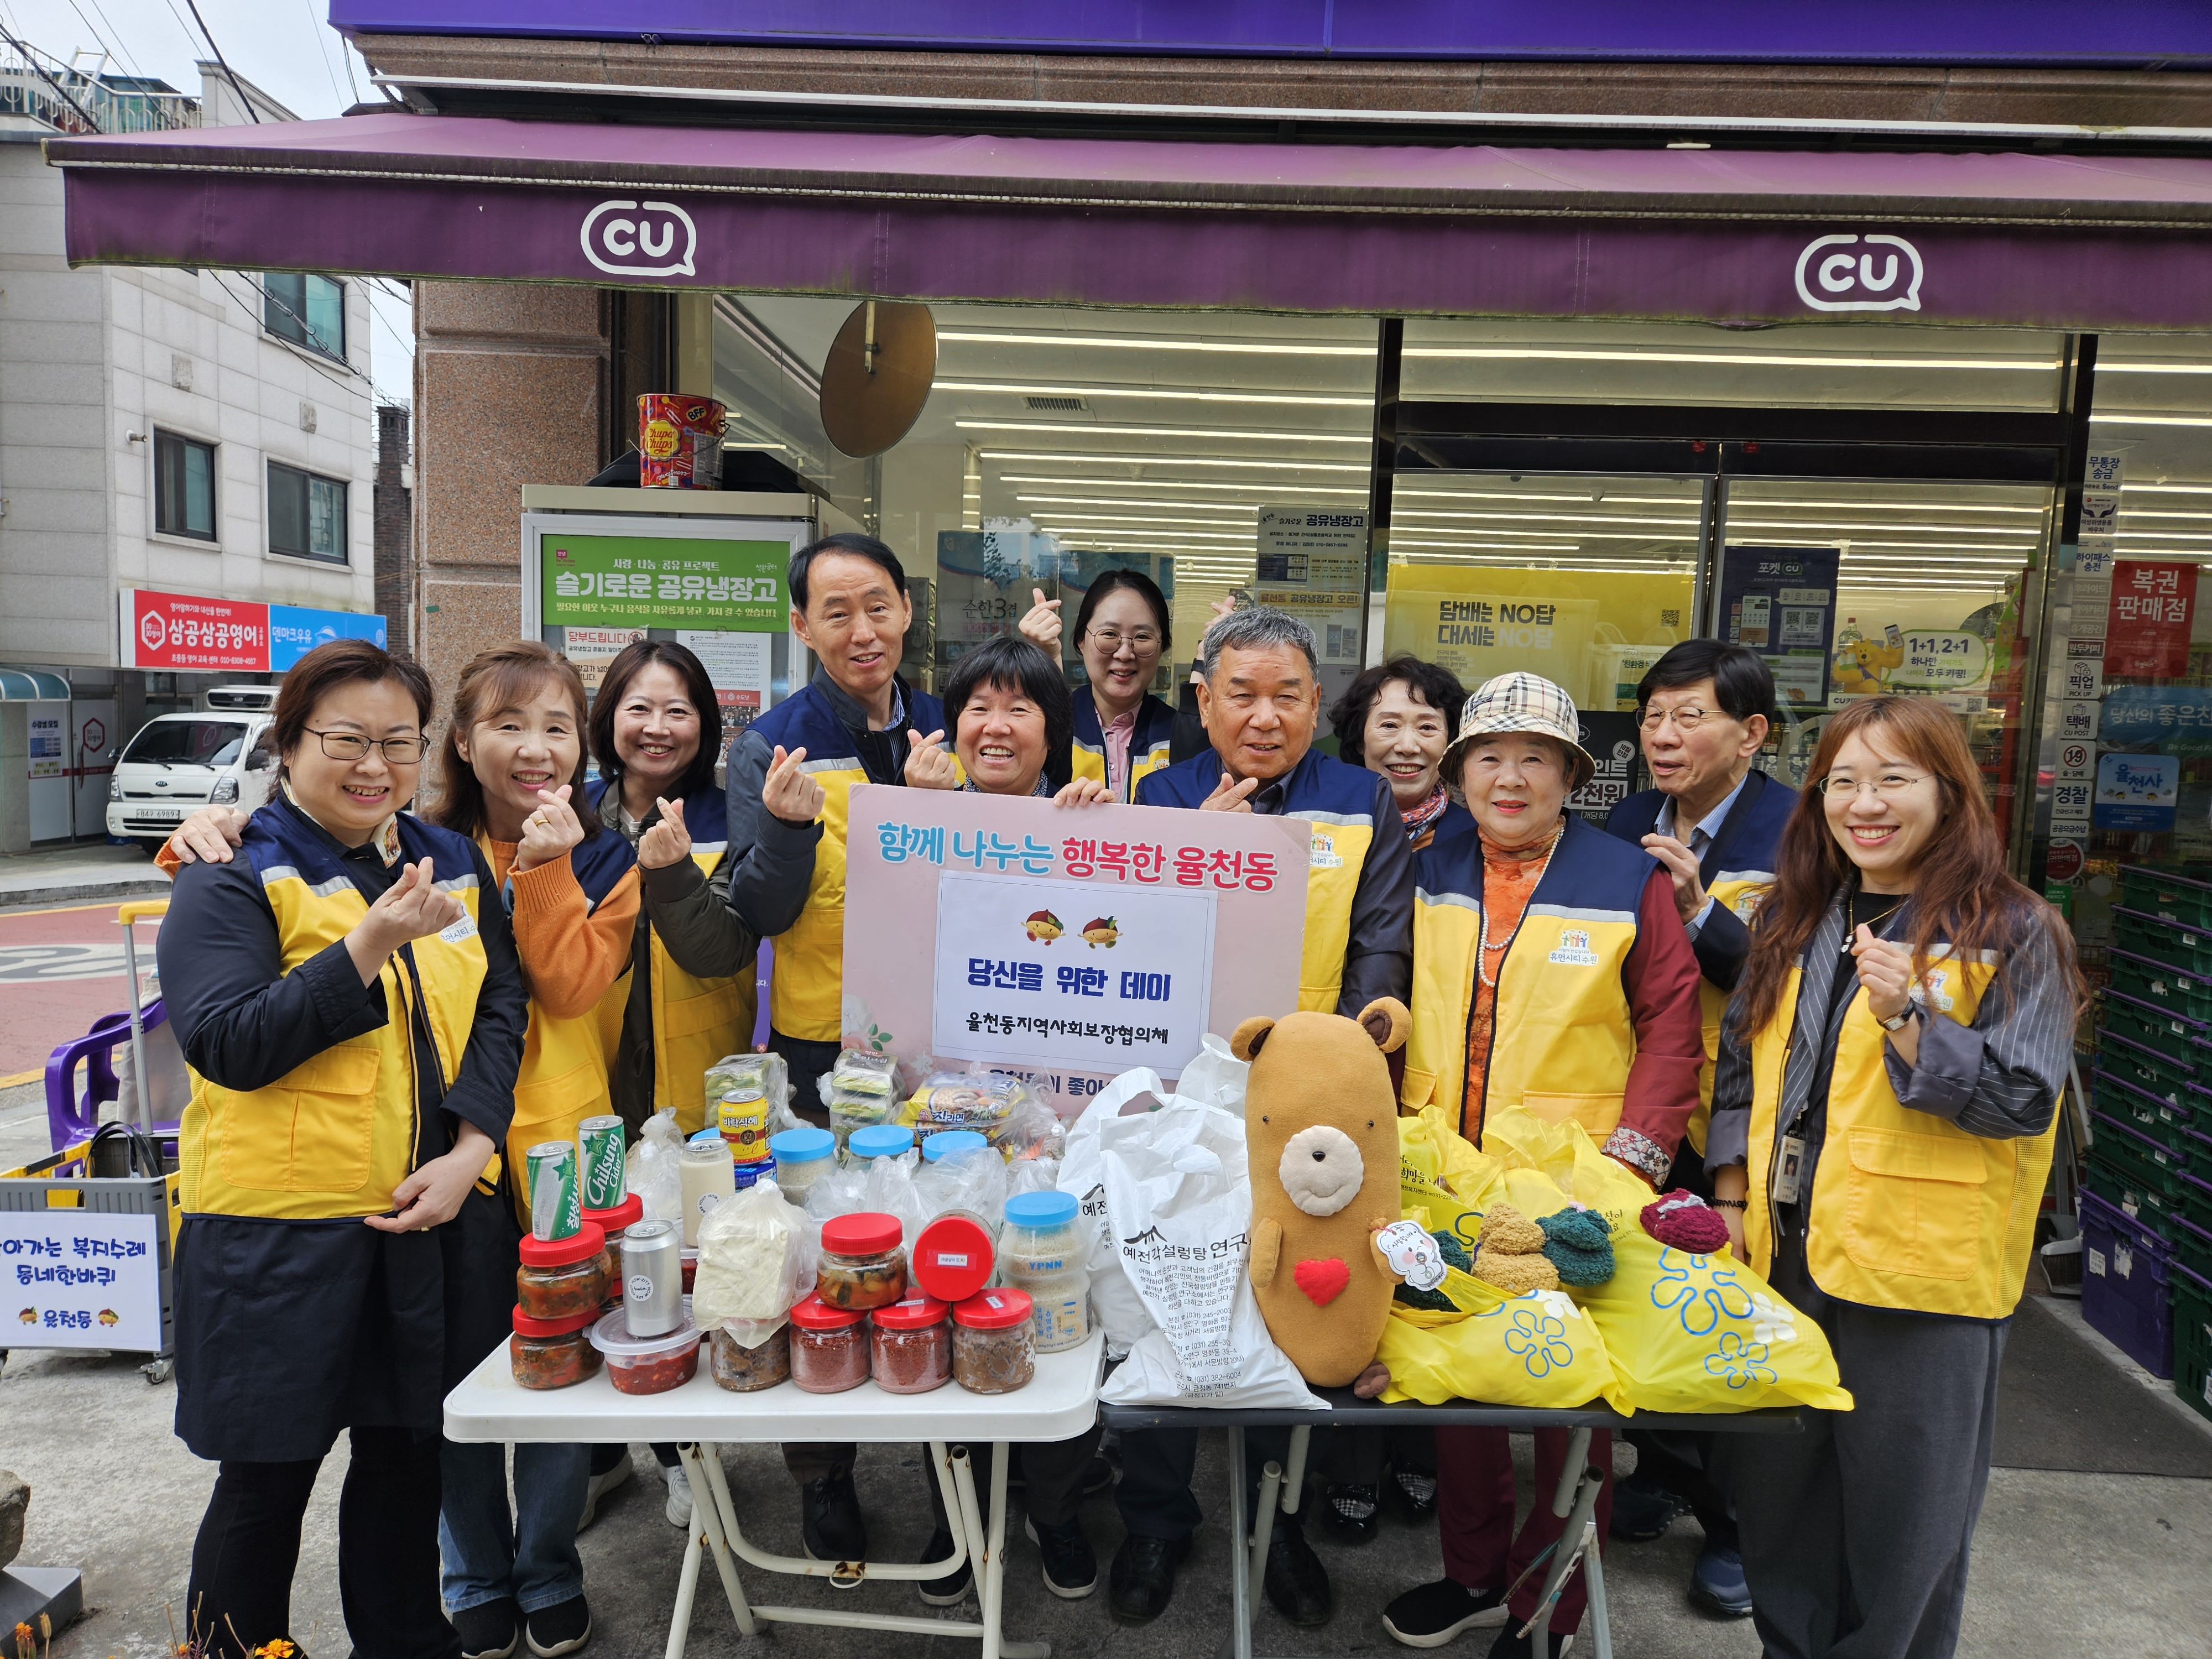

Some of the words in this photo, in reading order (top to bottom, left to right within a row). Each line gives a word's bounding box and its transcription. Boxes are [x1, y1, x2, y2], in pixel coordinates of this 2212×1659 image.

[687, 408, 705, 420] BFF
[649, 429, 674, 440] Chupa
[647, 439, 673, 453] Chups
[2089, 456, 2121, 468] 무통장
[2093, 468, 2113, 479] 송금
[1306, 514, 1364, 527] 공유냉장고
[2076, 552, 2111, 562] 하이패스
[683, 561, 720, 571] 프로젝트
[1758, 562, 1781, 575] 포켓
[2084, 562, 2101, 572] 충전
[555, 571, 653, 598] 슬기로운
[657, 575, 778, 602] 공유냉장고
[2131, 569, 2179, 594] 복권
[2075, 584, 2106, 593] 후라이드
[1260, 593, 1286, 603] 율천동
[1290, 593, 1333, 604] 공유냉장고
[1337, 595, 1358, 604] 오픈!
[556, 602, 580, 612] 필요한
[582, 603, 598, 613] 이웃
[601, 604, 624, 614] 누구나
[627, 604, 650, 614] 음식을
[652, 606, 684, 615] 자유롭게
[706, 607, 723, 617] 가져
[724, 607, 733, 617] 갈
[735, 608, 743, 617] 수
[745, 608, 776, 618] 있습니다
[1439, 601, 1493, 623] 담배는
[1499, 603, 1557, 625] NO답
[2117, 596, 2187, 622] 판매점
[168, 618, 257, 650] 삼공삼공영어
[272, 625, 312, 644] 덴마크우유
[1437, 624, 1495, 646] 대세는
[2070, 624, 2103, 634] 휴게공간
[568, 630, 627, 644] 당부드립니다
[1942, 638, 1969, 654] 2+1
[2068, 644, 2100, 654] 원두커피
[1911, 657, 1937, 666] 하나만
[1926, 669, 1944, 678] 모두
[1945, 669, 1966, 679] 키핑!
[2069, 676, 2094, 689] 픽업
[2066, 715, 2091, 729] 택배
[2111, 707, 2154, 724] 당신의
[1616, 749, 1629, 759] 한정
[1620, 743, 1632, 753] 10월
[2068, 749, 2083, 763] 19
[2056, 786, 2089, 805] 경찰
[1581, 811, 1598, 820] (개당
[2052, 825, 2086, 833] 공공요금수납
[877, 821, 945, 865] 함께
[953, 830, 1055, 874] 나누는
[1062, 836, 1167, 883] 행복한
[1172, 846, 1279, 892] 율천동
[1327, 857, 1342, 866] 수원
[1550, 952, 1580, 963] 휴먼시티
[1582, 955, 1597, 964] 수원
[968, 958, 1044, 992] 당신을
[1056, 966, 1109, 997] 위한
[1120, 971, 1171, 1001] 데이
[966, 1011, 1169, 1046] 율천동지역사회보장협의체
[722, 1114, 759, 1129] 비락식혜
[932, 1110, 965, 1124] 진라면
[587, 1133, 622, 1205] Chilsung
[609, 1152, 623, 1188] Cider
[1401, 1167, 1425, 1185] 희망을
[0, 1237, 62, 1258] 아가는
[72, 1237, 146, 1259] 복지수레
[1029, 1260, 1062, 1270] YPNN
[1139, 1267, 1162, 1277] 어머니의
[1180, 1266, 1205, 1274] 고객님의
[17, 1264, 116, 1286] 동네한바퀴
[1140, 1276, 1164, 1285] 생각하여
[1194, 1269, 1229, 1282] 전통비법으로
[1142, 1290, 1160, 1300] 예전각
[1178, 1289, 1215, 1298] 연구소에서는
[1217, 1285, 1235, 1295] 연구와
[1167, 1301, 1182, 1311] 최선을
[1205, 1294, 1232, 1306] 있습니다.
[44, 1310, 92, 1329] 율천동
[1203, 1308, 1232, 1319] 245-2003
[1202, 1318, 1219, 1327] 영화동
[1185, 1329, 1201, 1337] 사거리
[1203, 1324, 1227, 1334] 서울방향
[1191, 1341, 1206, 1350] (031)
[1202, 1349, 1220, 1358] 영화동
[1205, 1358, 1229, 1367] 서문방향
[1211, 1371, 1241, 1381] 382-6004
[1193, 1384, 1212, 1392] 금정동
[1214, 1381, 1237, 1390] 741번지
